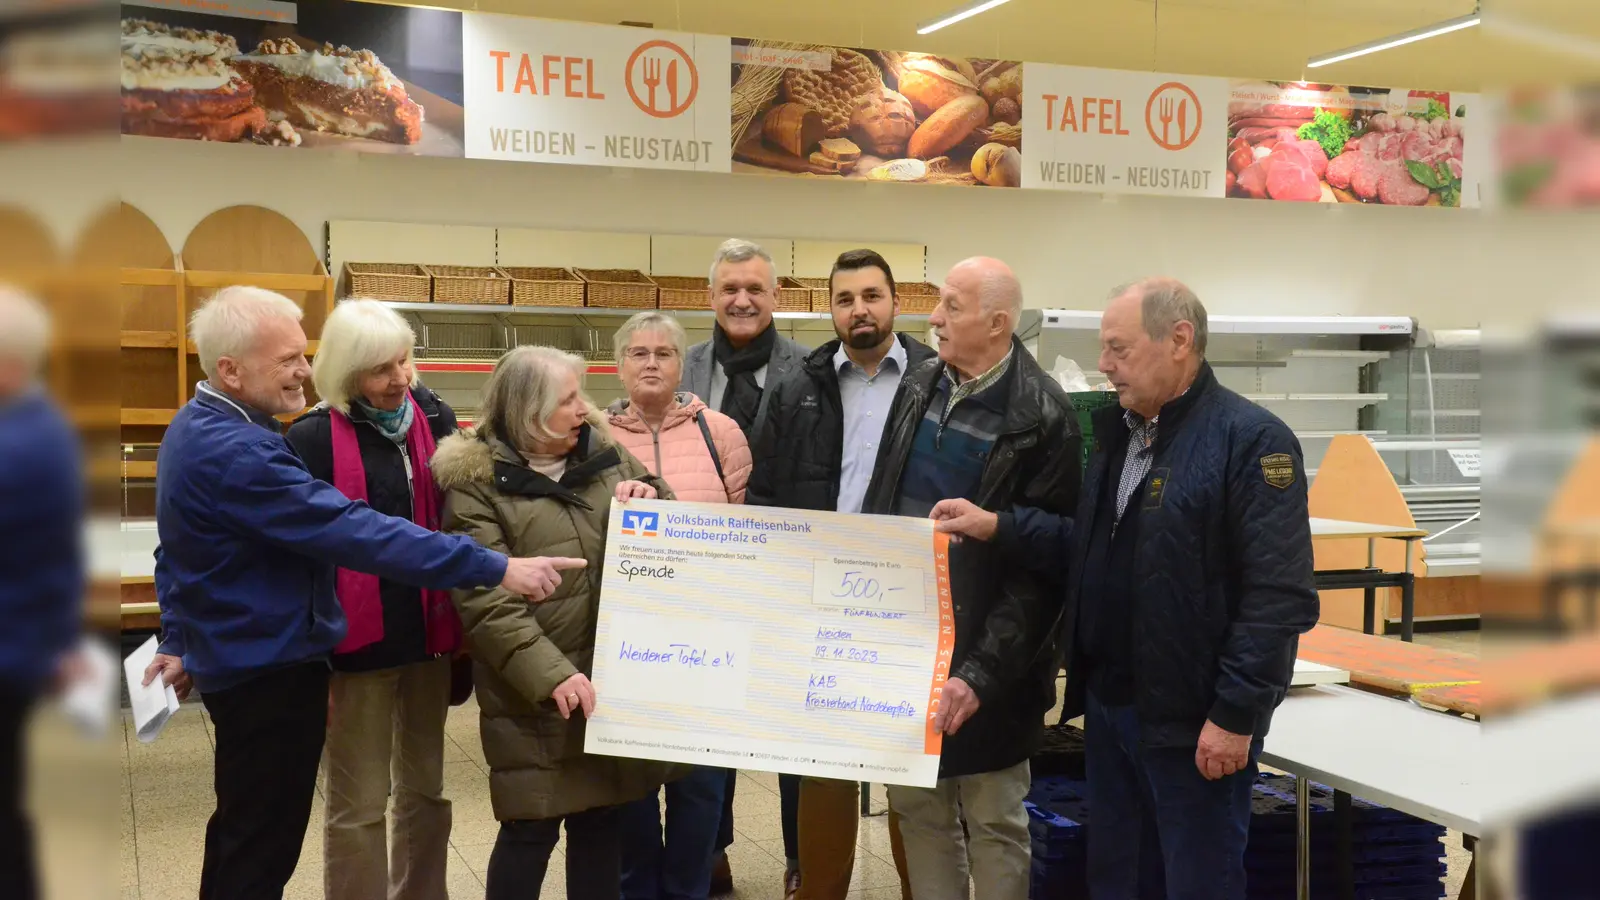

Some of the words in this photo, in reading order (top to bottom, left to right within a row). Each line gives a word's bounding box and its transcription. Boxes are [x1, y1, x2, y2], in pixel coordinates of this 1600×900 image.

[489, 50, 605, 100] TAFEL
[1231, 90, 1255, 101] Fleisch
[1260, 93, 1280, 101] Wurst
[1042, 94, 1129, 136] TAFEL
[489, 126, 576, 156] WEIDEN
[604, 134, 713, 164] NEUSTADT
[1040, 160, 1106, 186] WEIDEN
[1127, 166, 1212, 191] NEUSTADT
[666, 513, 725, 528] Volksbank
[728, 517, 812, 533] Raiffeisenbank
[664, 527, 749, 544] Nordoberpfalz
[751, 533, 767, 544] eG
[618, 551, 656, 560] überreichen
[632, 545, 653, 553] freuen
[705, 551, 735, 559] folgenden
[617, 560, 675, 582] Spende
[833, 557, 879, 568] Spendenbetrag
[879, 560, 886, 568] in
[886, 561, 901, 569] Euro
[816, 626, 852, 640] Weiden
[619, 640, 674, 663] Weidener
[669, 644, 707, 669] Tafel
[847, 647, 879, 664] 2023
[808, 674, 838, 689] KAB
[860, 695, 916, 718] Nordoberpfalz
